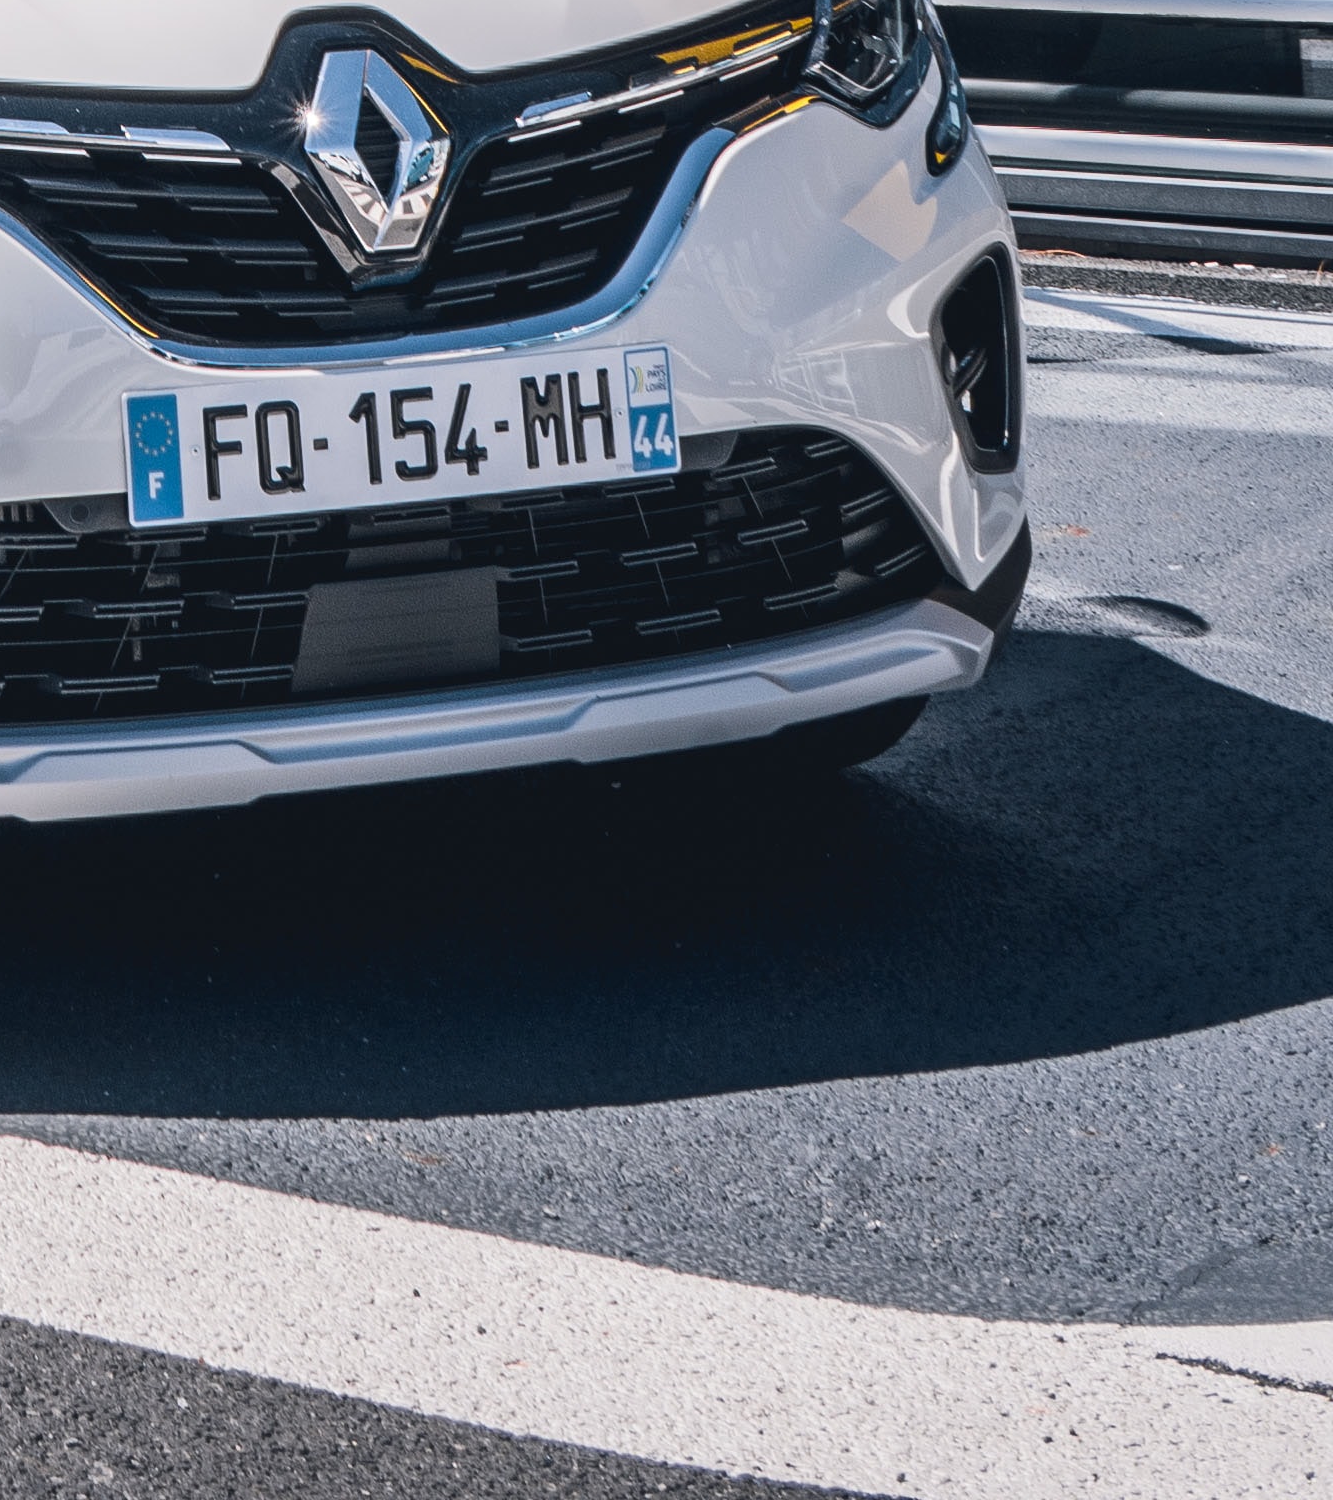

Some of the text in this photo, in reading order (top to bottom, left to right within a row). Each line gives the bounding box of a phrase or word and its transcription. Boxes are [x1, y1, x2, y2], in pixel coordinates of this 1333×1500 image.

[201, 366, 618, 502] FQ-154-MH
[634, 412, 674, 459] 44
[148, 470, 164, 500] F
